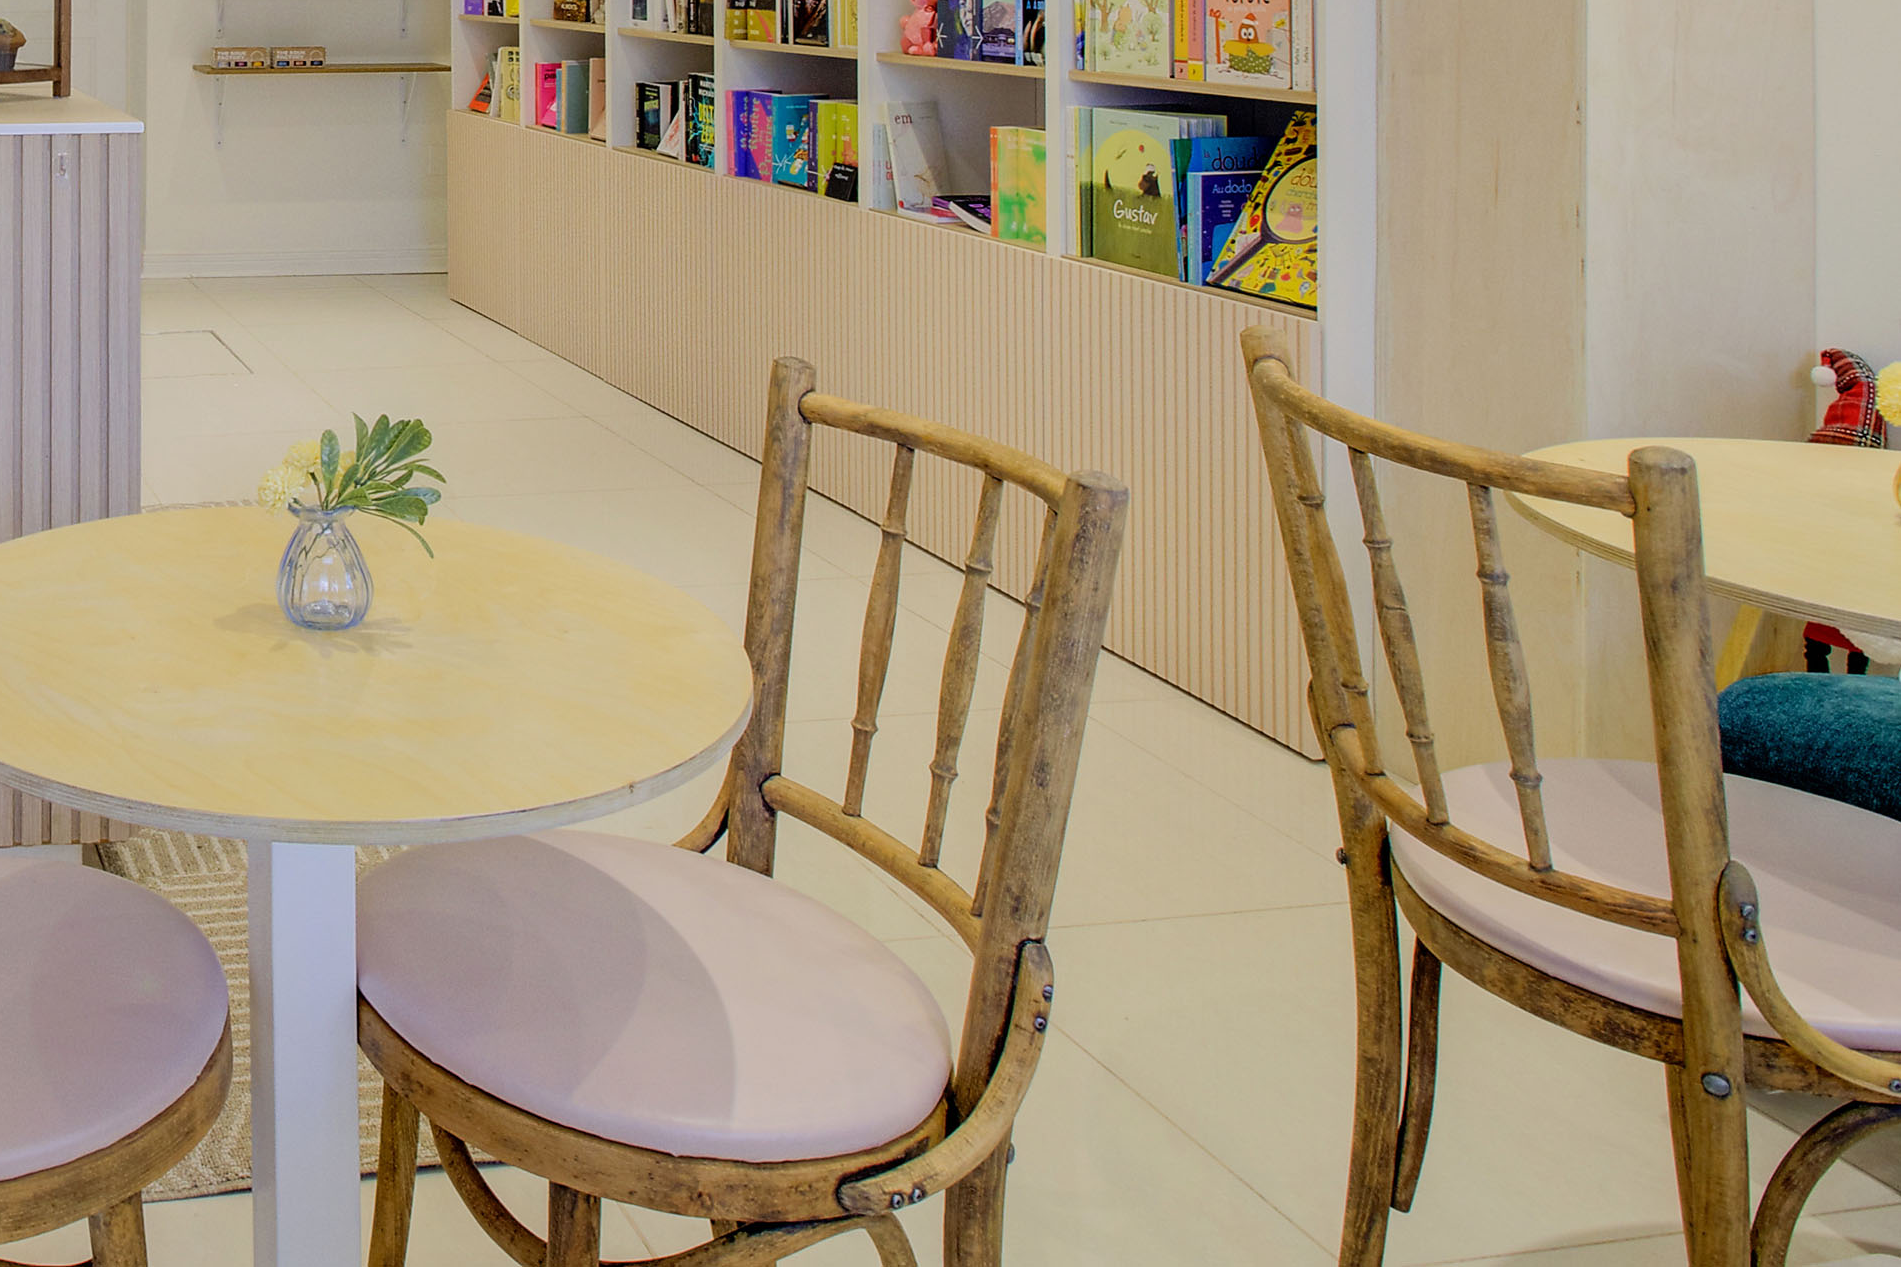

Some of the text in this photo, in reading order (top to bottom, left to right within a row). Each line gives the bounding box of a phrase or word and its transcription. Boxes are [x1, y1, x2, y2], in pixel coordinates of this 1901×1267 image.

[894, 113, 913, 125] em
[1225, 180, 1252, 194] dodo
[1113, 199, 1158, 225] Gustav
